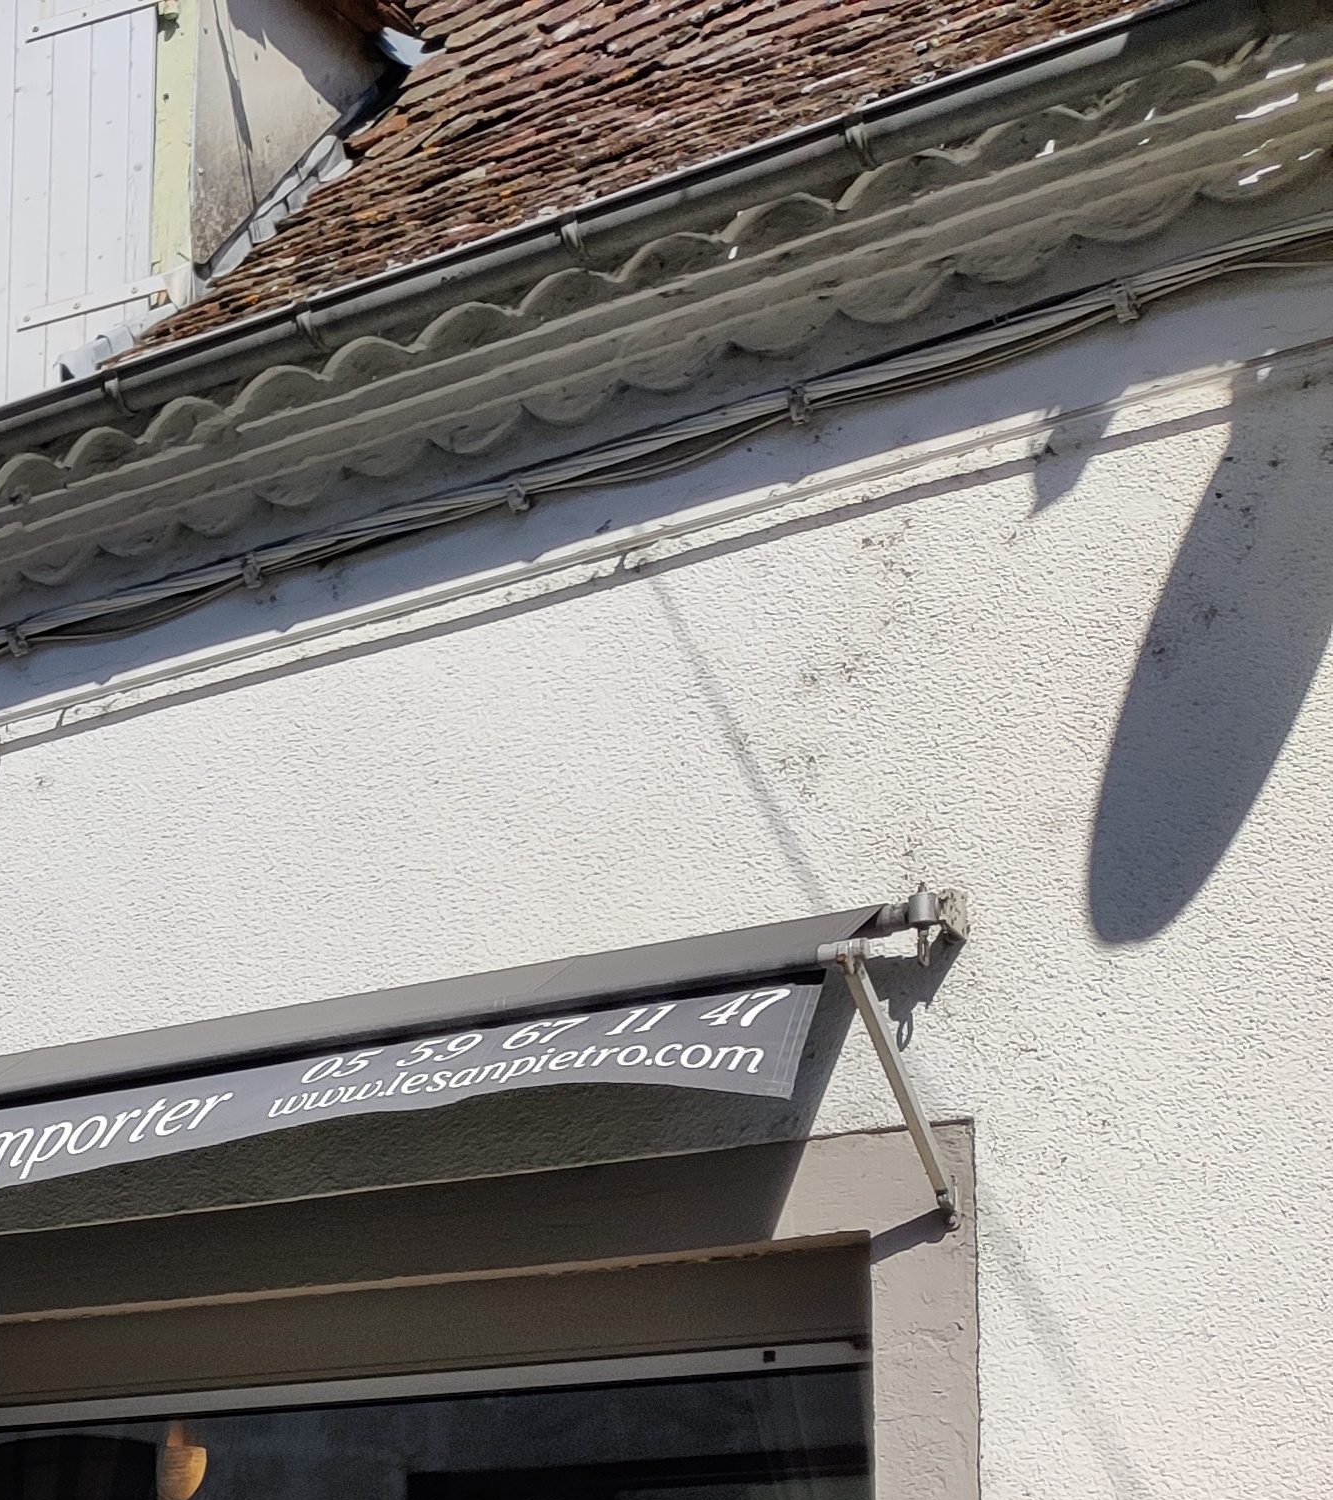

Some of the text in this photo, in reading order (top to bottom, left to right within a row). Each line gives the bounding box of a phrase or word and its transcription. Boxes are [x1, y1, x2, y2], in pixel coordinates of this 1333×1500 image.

[300, 988, 791, 1084] 05 59 67 11 47
[267, 1043, 766, 1119] www.lesanpietro.com
